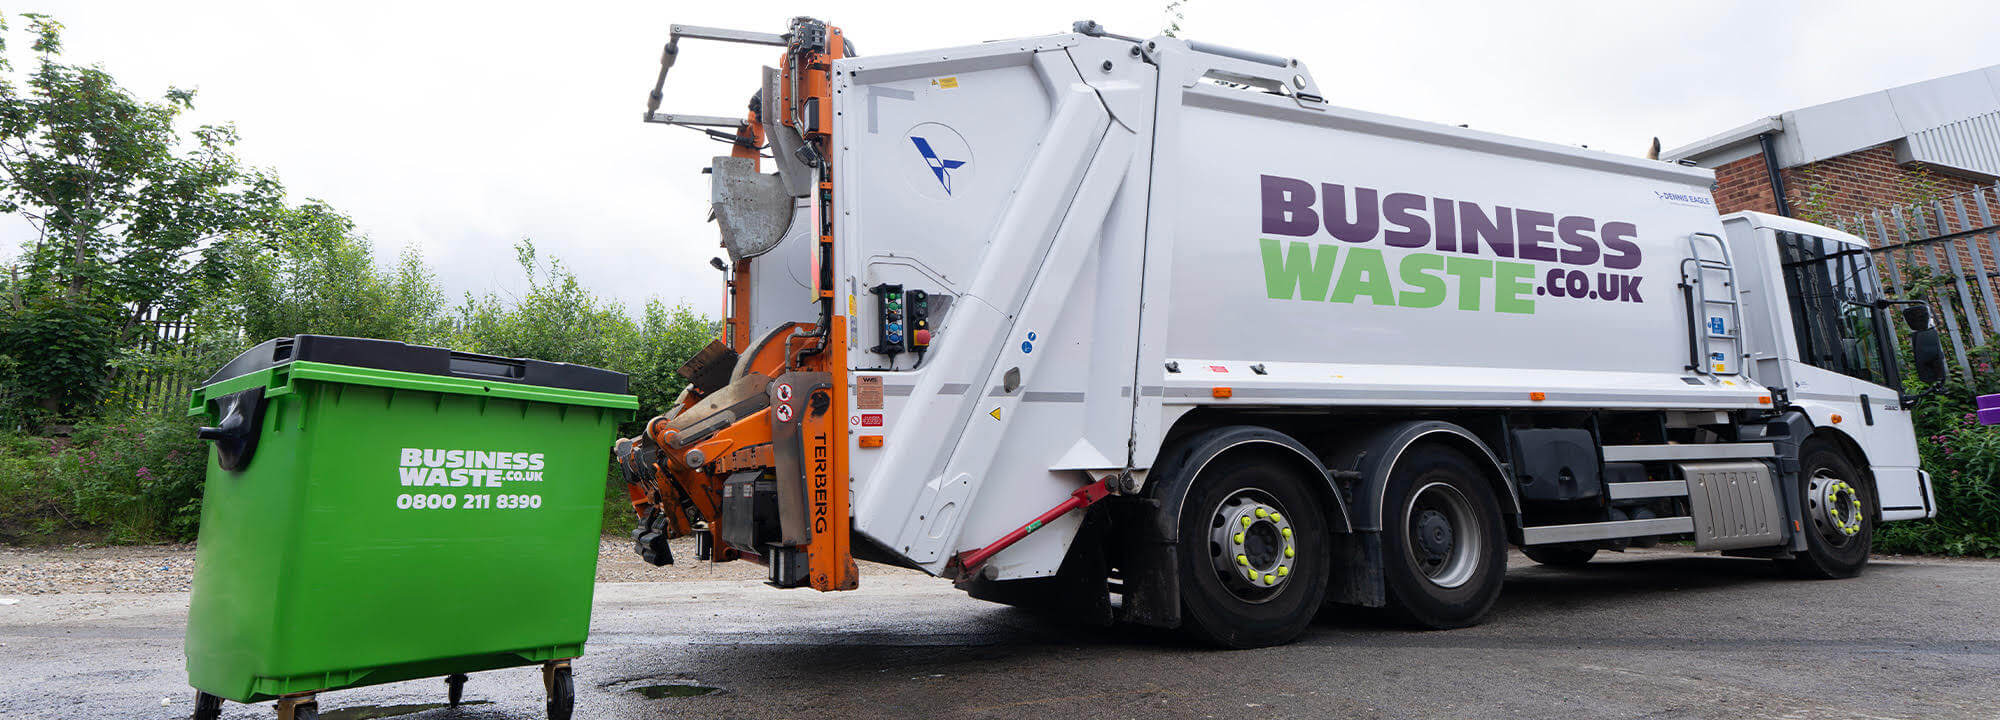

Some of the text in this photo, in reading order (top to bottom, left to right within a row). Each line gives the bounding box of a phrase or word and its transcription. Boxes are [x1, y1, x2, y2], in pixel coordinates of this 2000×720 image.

[1663, 191, 1689, 202] DENNIS
[1689, 195, 1711, 205] EAGLE
[1260, 174, 1643, 270] BUSINESS
[400, 447, 545, 470] BUSINESS
[813, 431, 828, 534] TERBERG
[396, 493, 542, 510] 0800 211 8390
